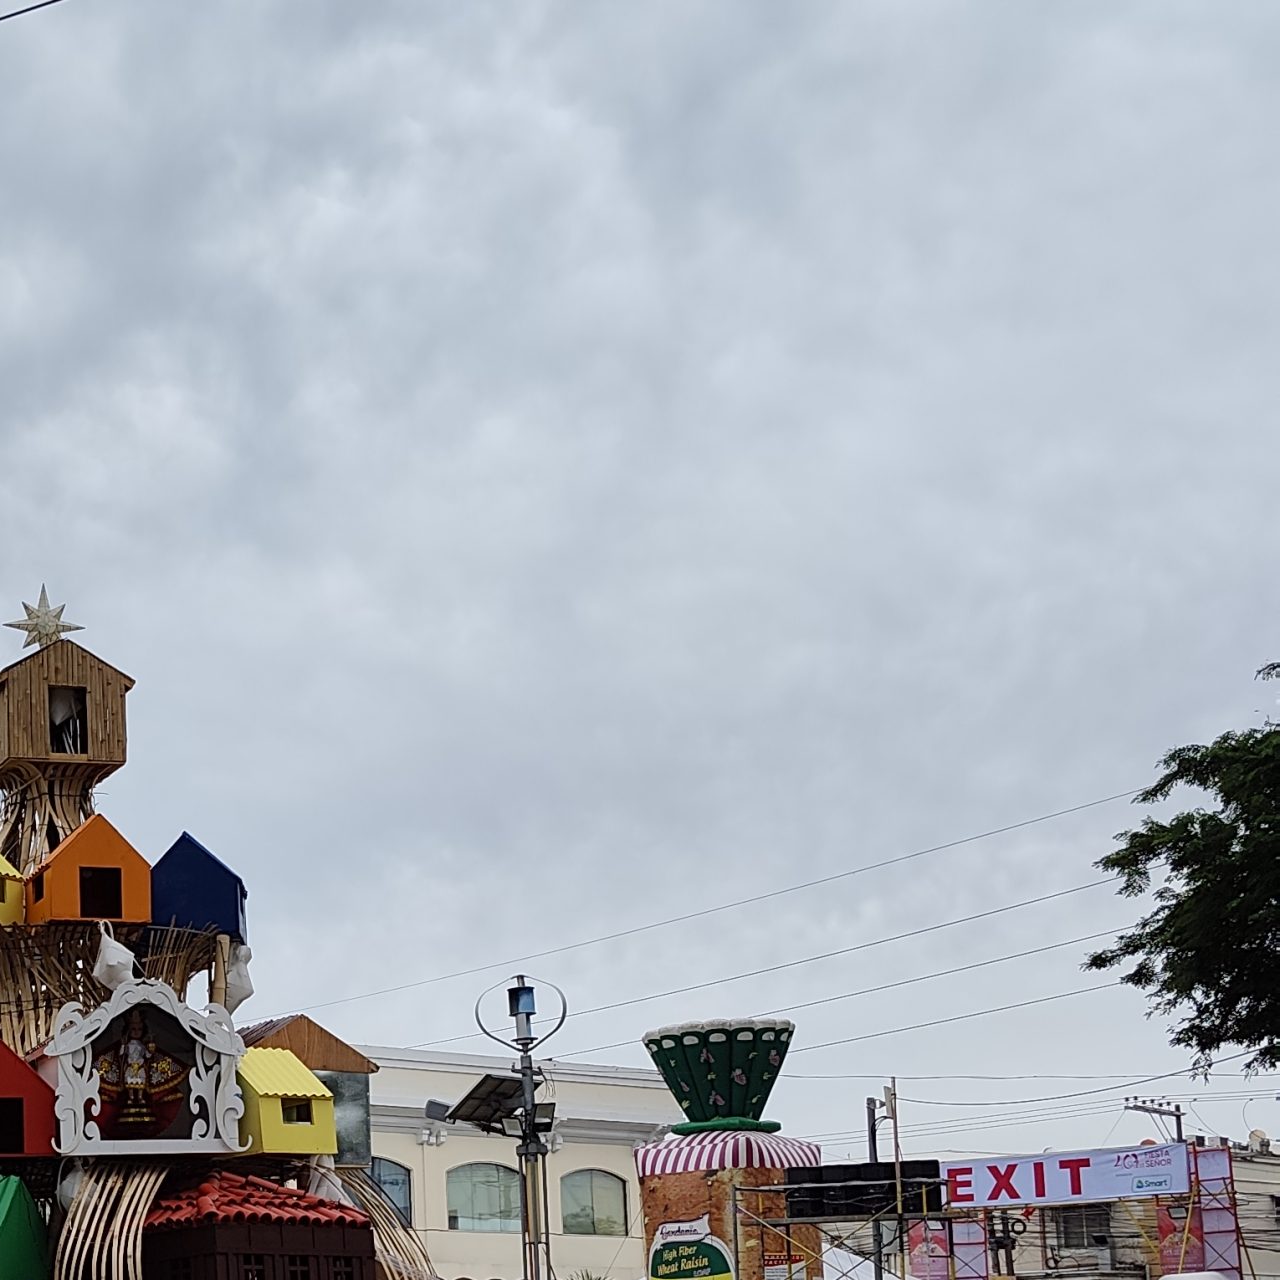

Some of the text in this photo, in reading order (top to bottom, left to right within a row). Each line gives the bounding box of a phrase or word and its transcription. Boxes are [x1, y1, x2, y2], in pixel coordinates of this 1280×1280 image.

[1144, 1149, 1170, 1159] FIESTA
[946, 1158, 1091, 1203] EXIT
[1144, 1179, 1168, 1188] Smart
[679, 1245, 698, 1257] Fiber
[657, 1255, 709, 1277] Wheat Raisin
